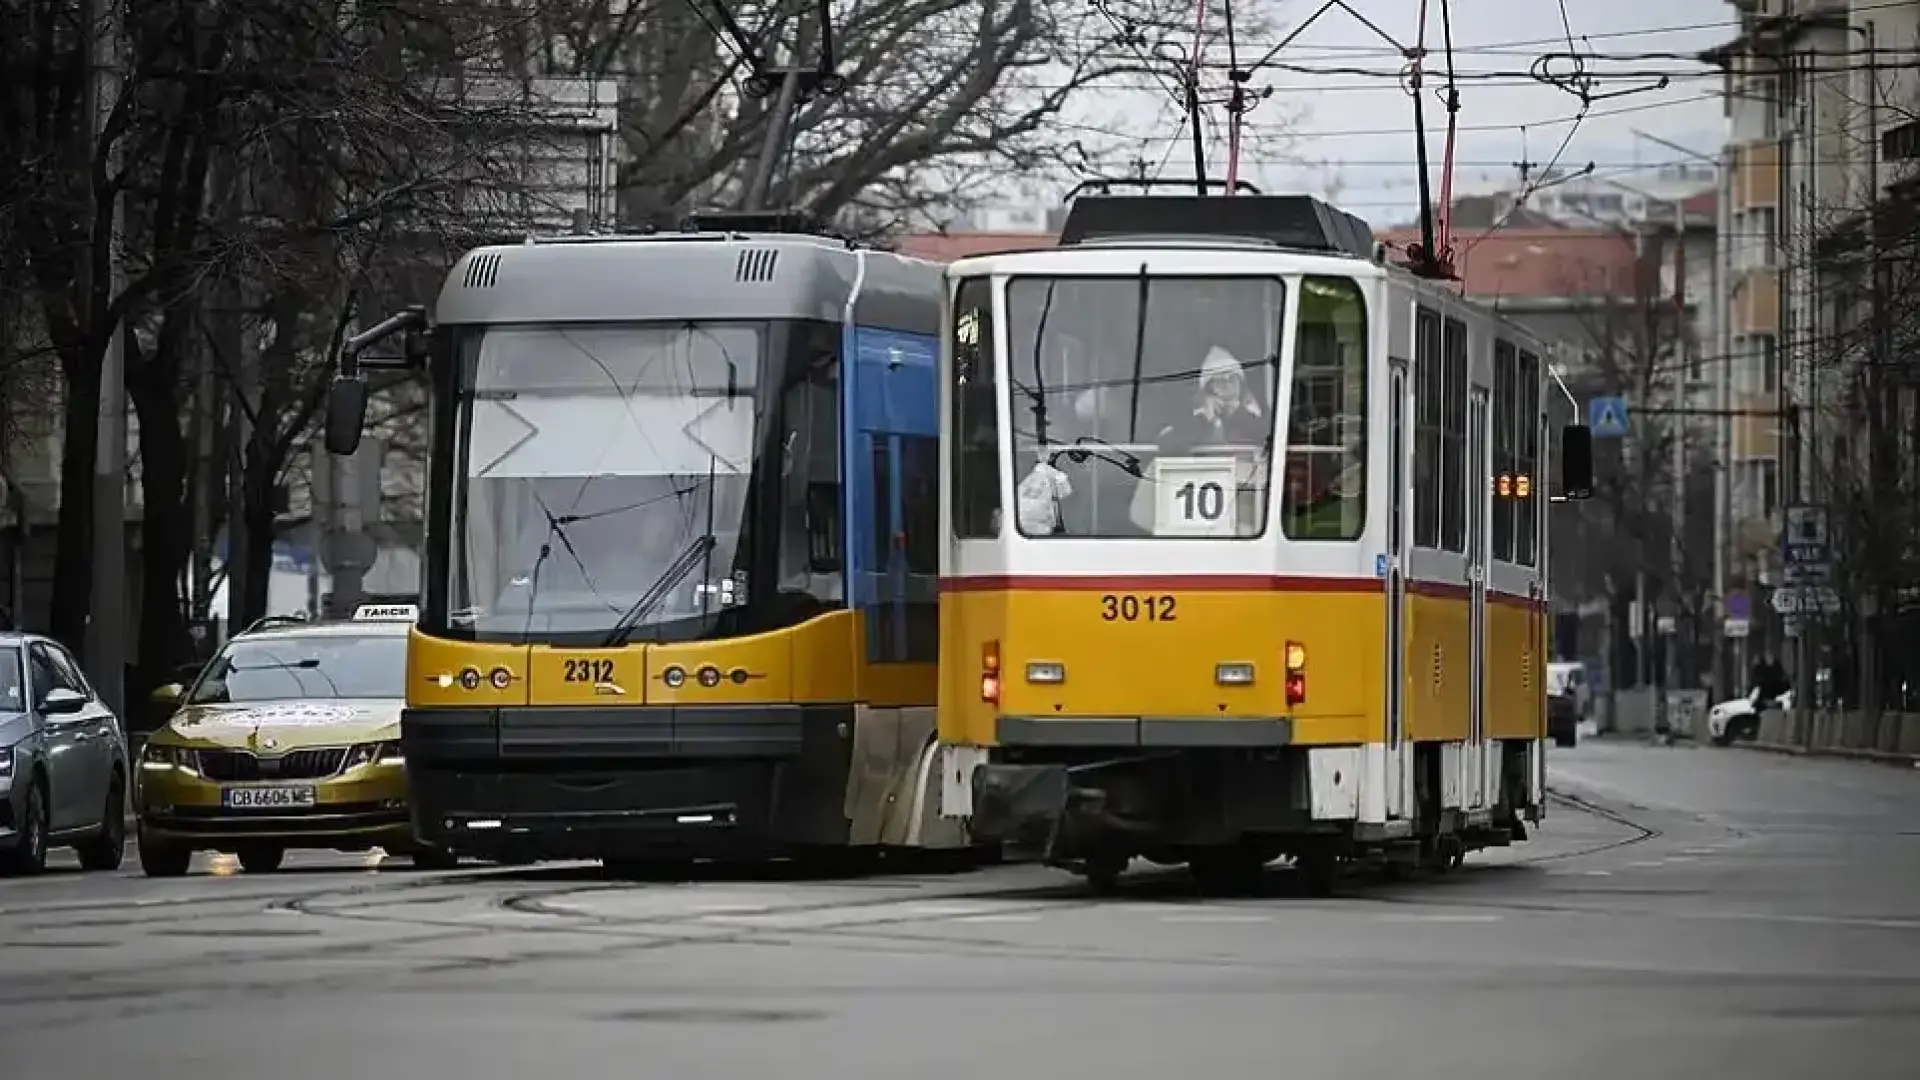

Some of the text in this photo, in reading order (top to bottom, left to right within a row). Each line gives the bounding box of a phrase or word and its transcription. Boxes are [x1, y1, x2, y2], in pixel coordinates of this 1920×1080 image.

[1175, 481, 1224, 520] 10
[1101, 595, 1177, 621] 3012
[564, 659, 614, 682] 2312
